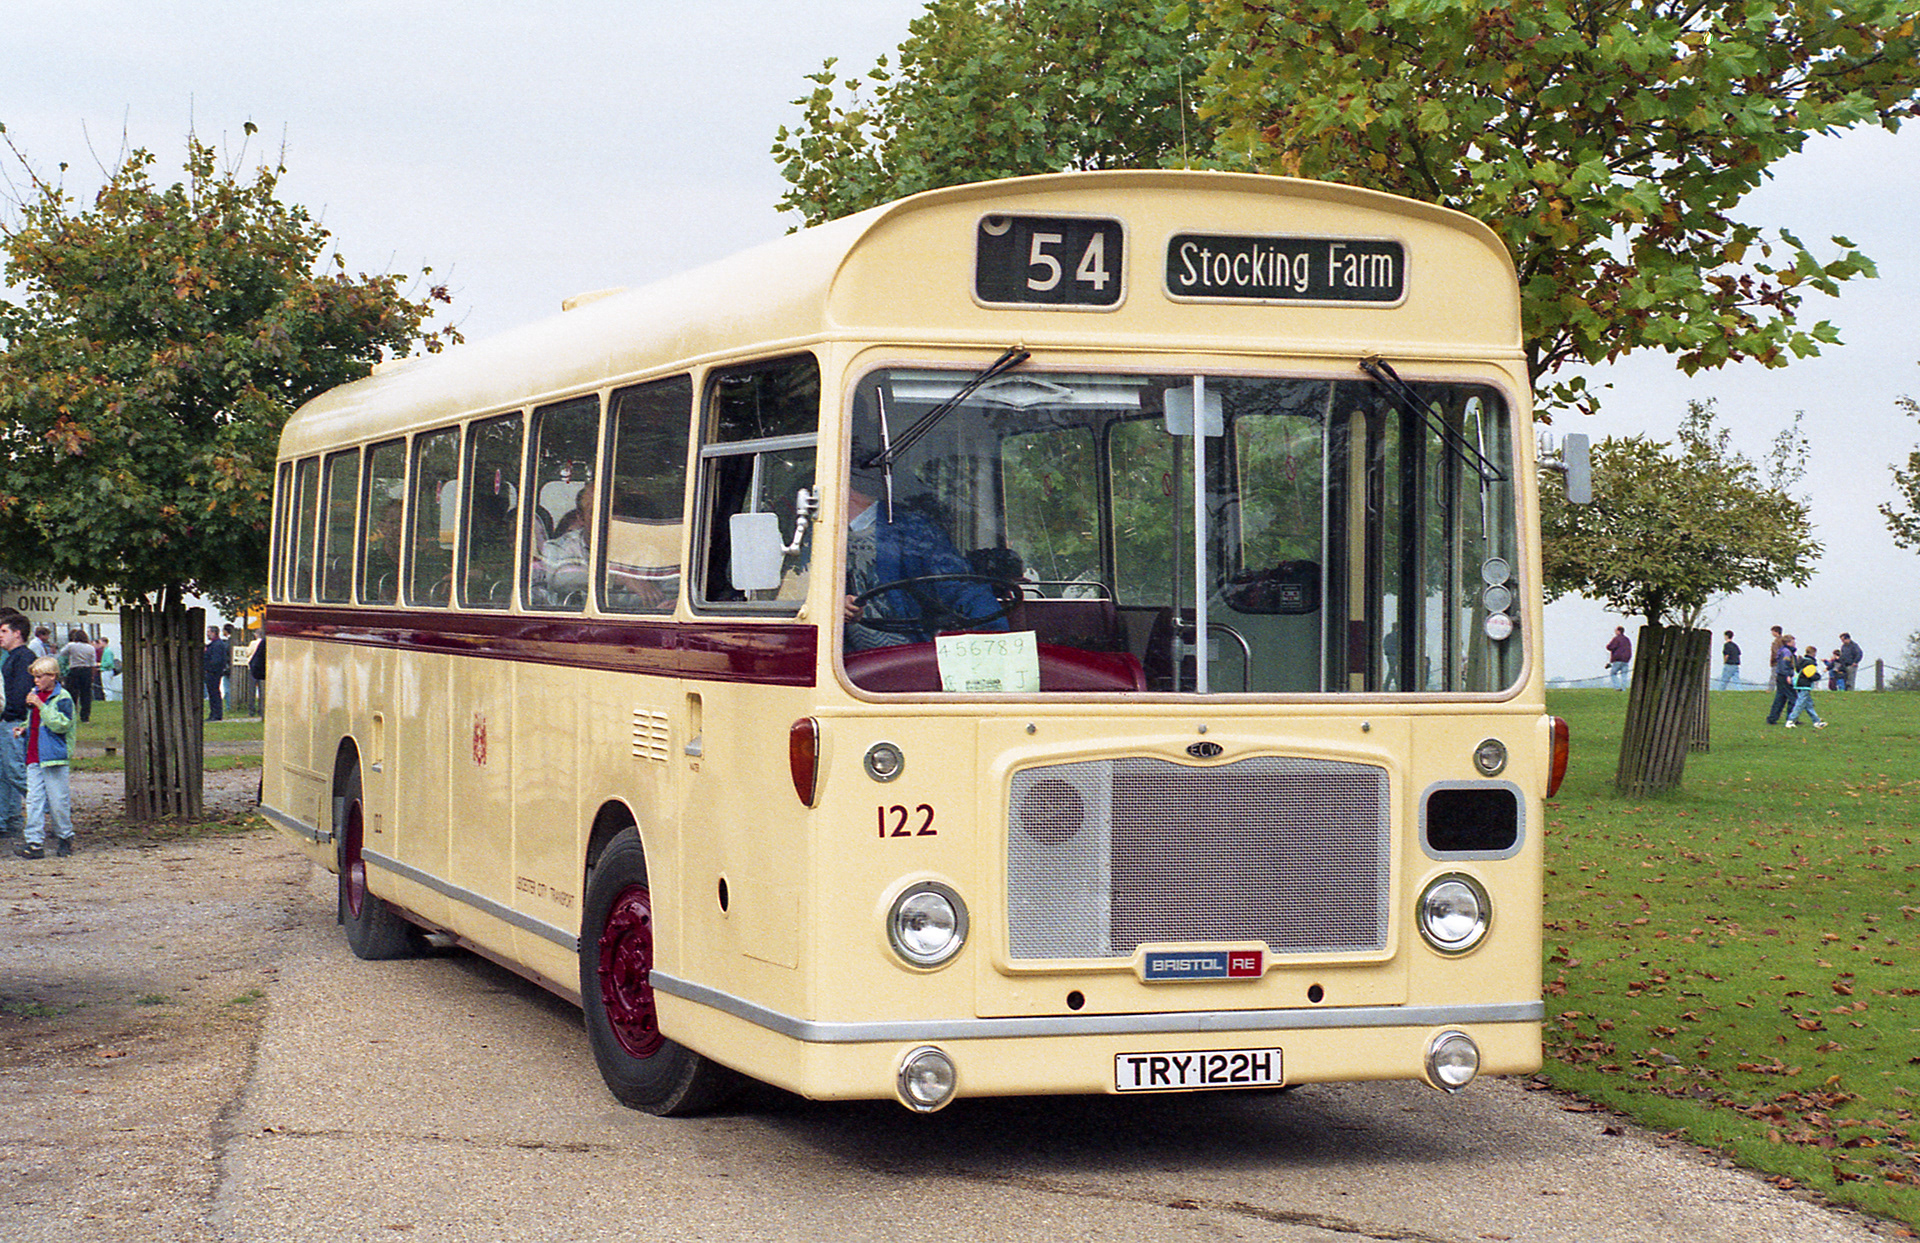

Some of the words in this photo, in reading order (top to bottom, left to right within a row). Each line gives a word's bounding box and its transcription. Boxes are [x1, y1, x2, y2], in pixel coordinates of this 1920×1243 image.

[1027, 232, 1110, 291] 54
[1179, 241, 1310, 293] Stocking
[1328, 243, 1393, 288] Farm
[17, 596, 59, 612] ONLY
[1187, 742, 1221, 757] ECW
[877, 803, 938, 838] 122
[1152, 958, 1223, 972] BRISTOL
[1232, 958, 1255, 970] RE
